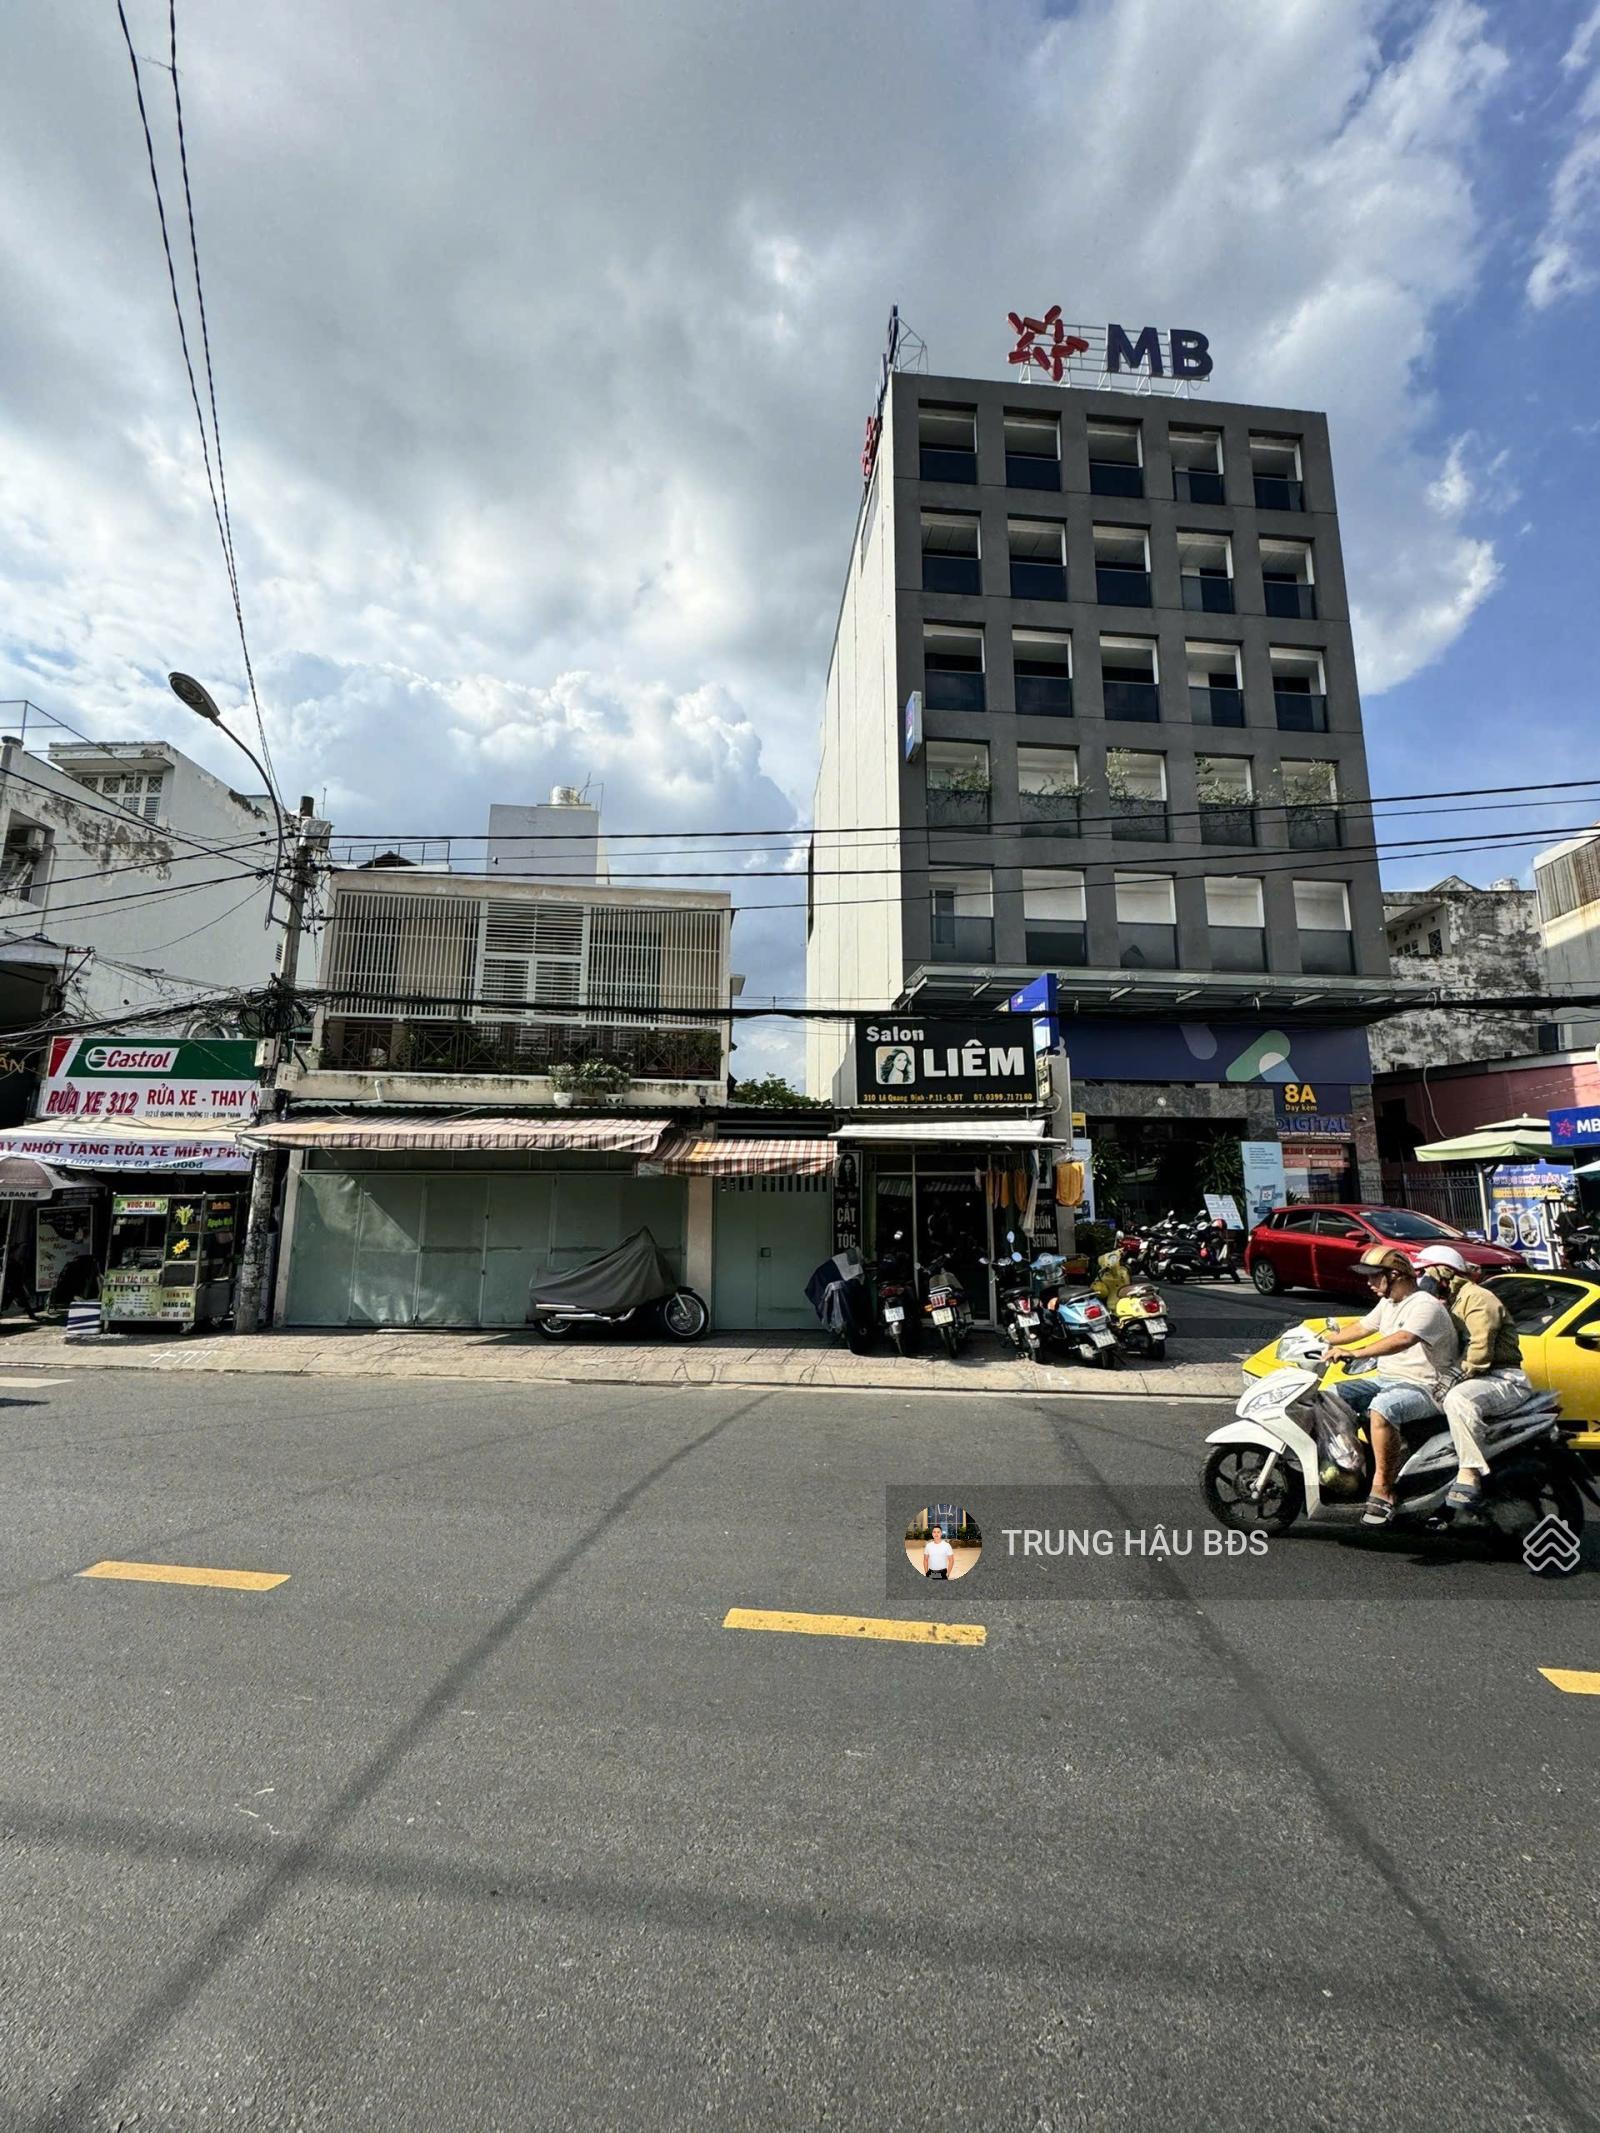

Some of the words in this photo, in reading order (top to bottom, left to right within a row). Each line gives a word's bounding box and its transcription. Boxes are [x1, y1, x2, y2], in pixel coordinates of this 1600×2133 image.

[1106, 323, 1214, 379] MB
[866, 1025, 925, 1042] Salon
[107, 1049, 171, 1069] Castrol
[923, 1038, 1025, 1078] LIÊM
[46, 1081, 81, 1115] RỬA
[81, 1091, 106, 1115] XE
[106, 1091, 140, 1116] 312
[147, 1082, 175, 1105] RỬA
[179, 1089, 198, 1106] XE
[211, 1090, 247, 1106] THAY
[1284, 1083, 1317, 1104] 8A
[1576, 1117, 1600, 1134] MB
[21, 1139, 64, 1154] NHỚT
[68, 1141, 110, 1157] TẶNG
[114, 1140, 145, 1156] RỬA
[149, 1145, 170, 1157] XE
[174, 1141, 212, 1158] MIỄN
[836, 1201, 856, 1223] CẮT
[836, 1229, 856, 1248] TÓC
[1032, 1233, 1057, 1248] SETTING
